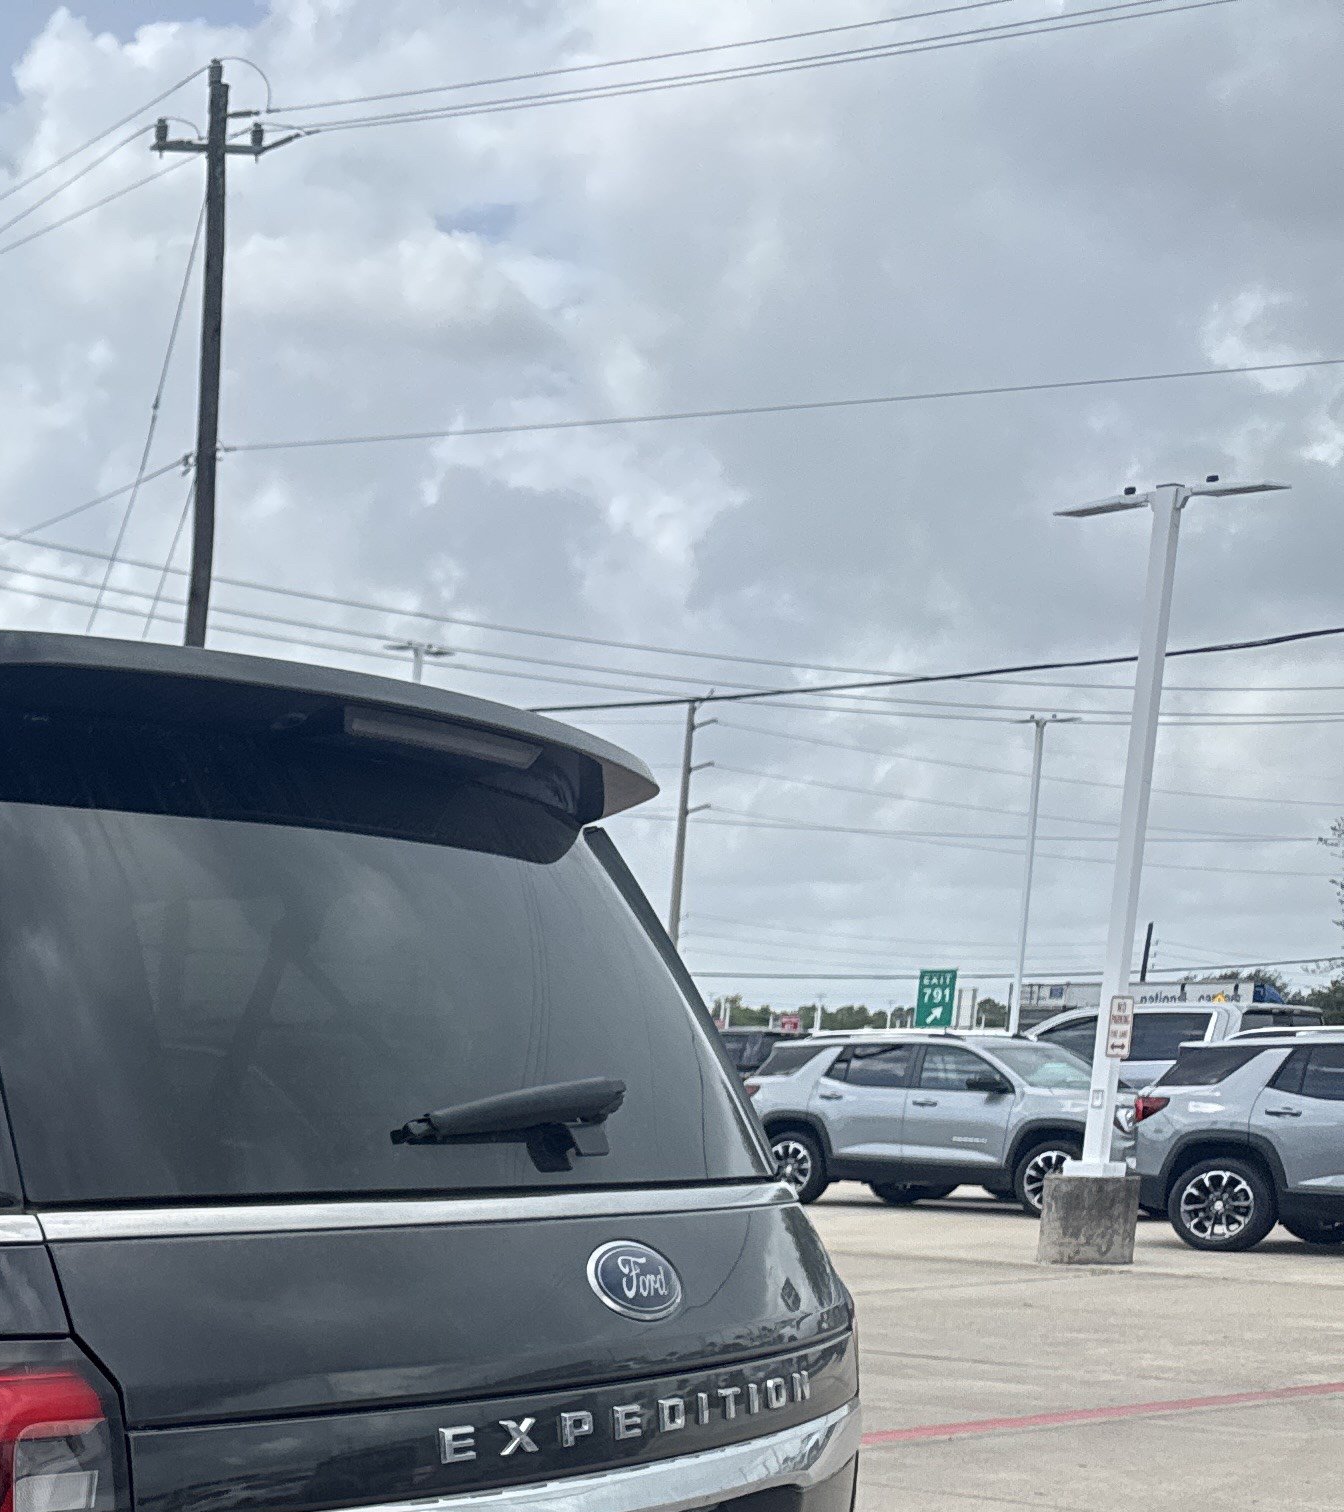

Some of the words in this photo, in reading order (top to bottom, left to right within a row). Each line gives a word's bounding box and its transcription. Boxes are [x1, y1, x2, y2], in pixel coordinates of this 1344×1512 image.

[923, 974, 950, 985] EXIT
[923, 987, 950, 1003] 791
[617, 1255, 668, 1299] Ford
[438, 1370, 811, 1465] EXPEDITION
